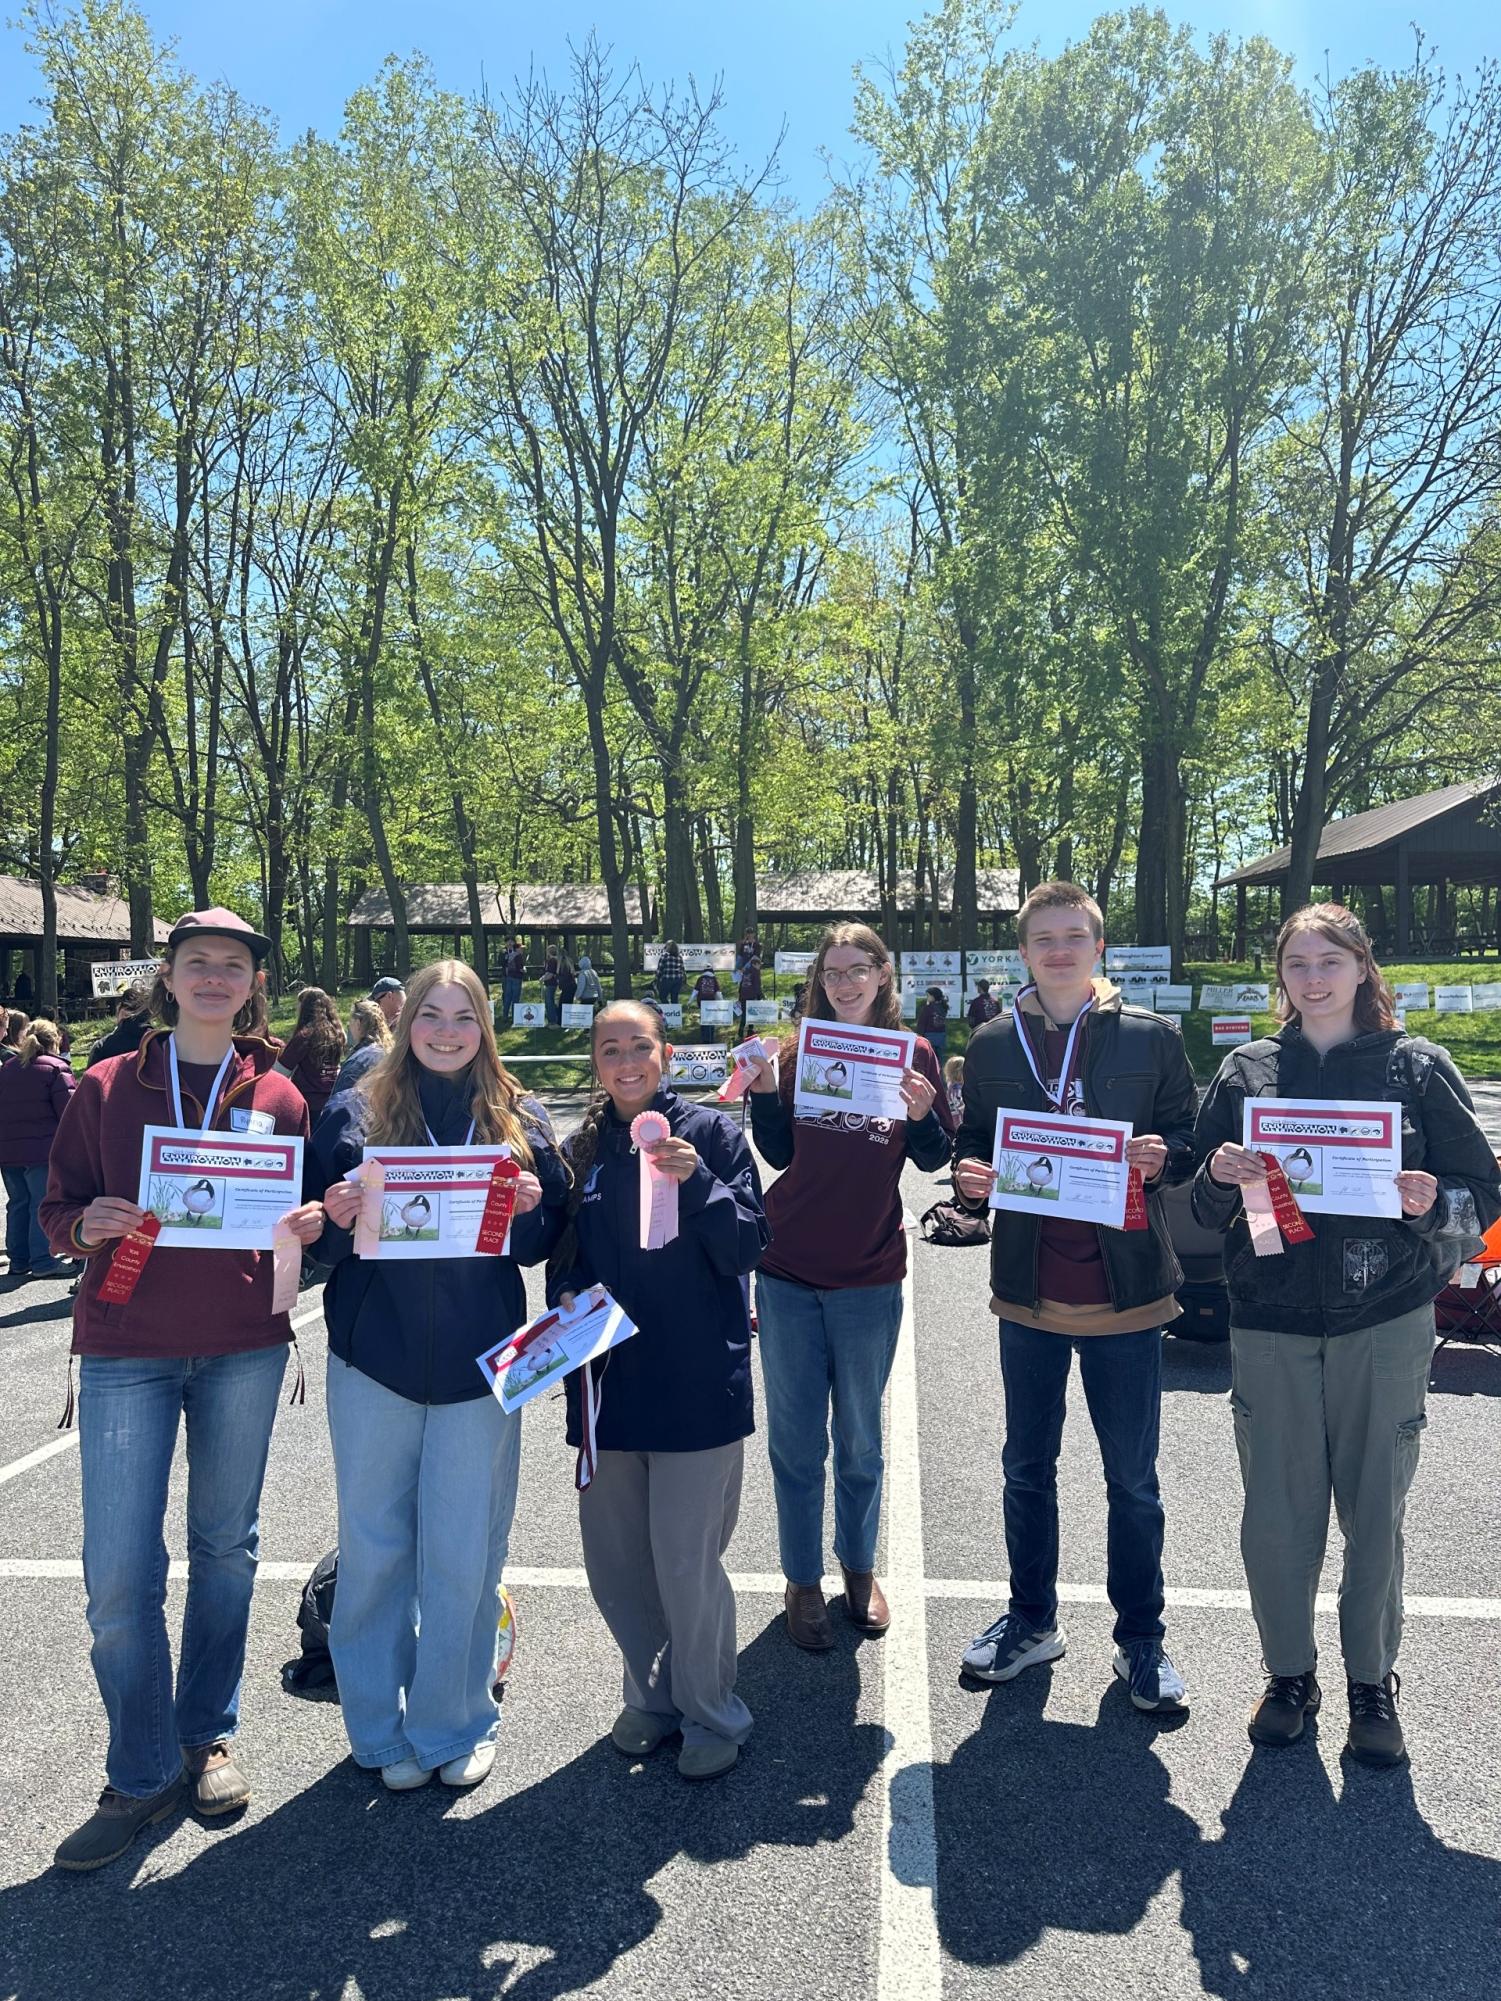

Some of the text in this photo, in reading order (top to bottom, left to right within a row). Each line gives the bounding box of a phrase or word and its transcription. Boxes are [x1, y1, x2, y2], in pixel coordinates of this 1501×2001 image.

[812, 1038, 868, 1054] ENVIROTHON
[1261, 1122, 1337, 1135] ENVIROTHON
[1011, 1131, 1076, 1147] ENVIROTHON
[162, 1152, 242, 1166] ENVIROTHON
[1283, 1220, 1304, 1229] SECOND
[482, 1229, 504, 1238] SECOND
[1288, 1226, 1304, 1234] PLACE
[121, 1255, 141, 1265] County
[107, 1280, 132, 1290] SECOND
